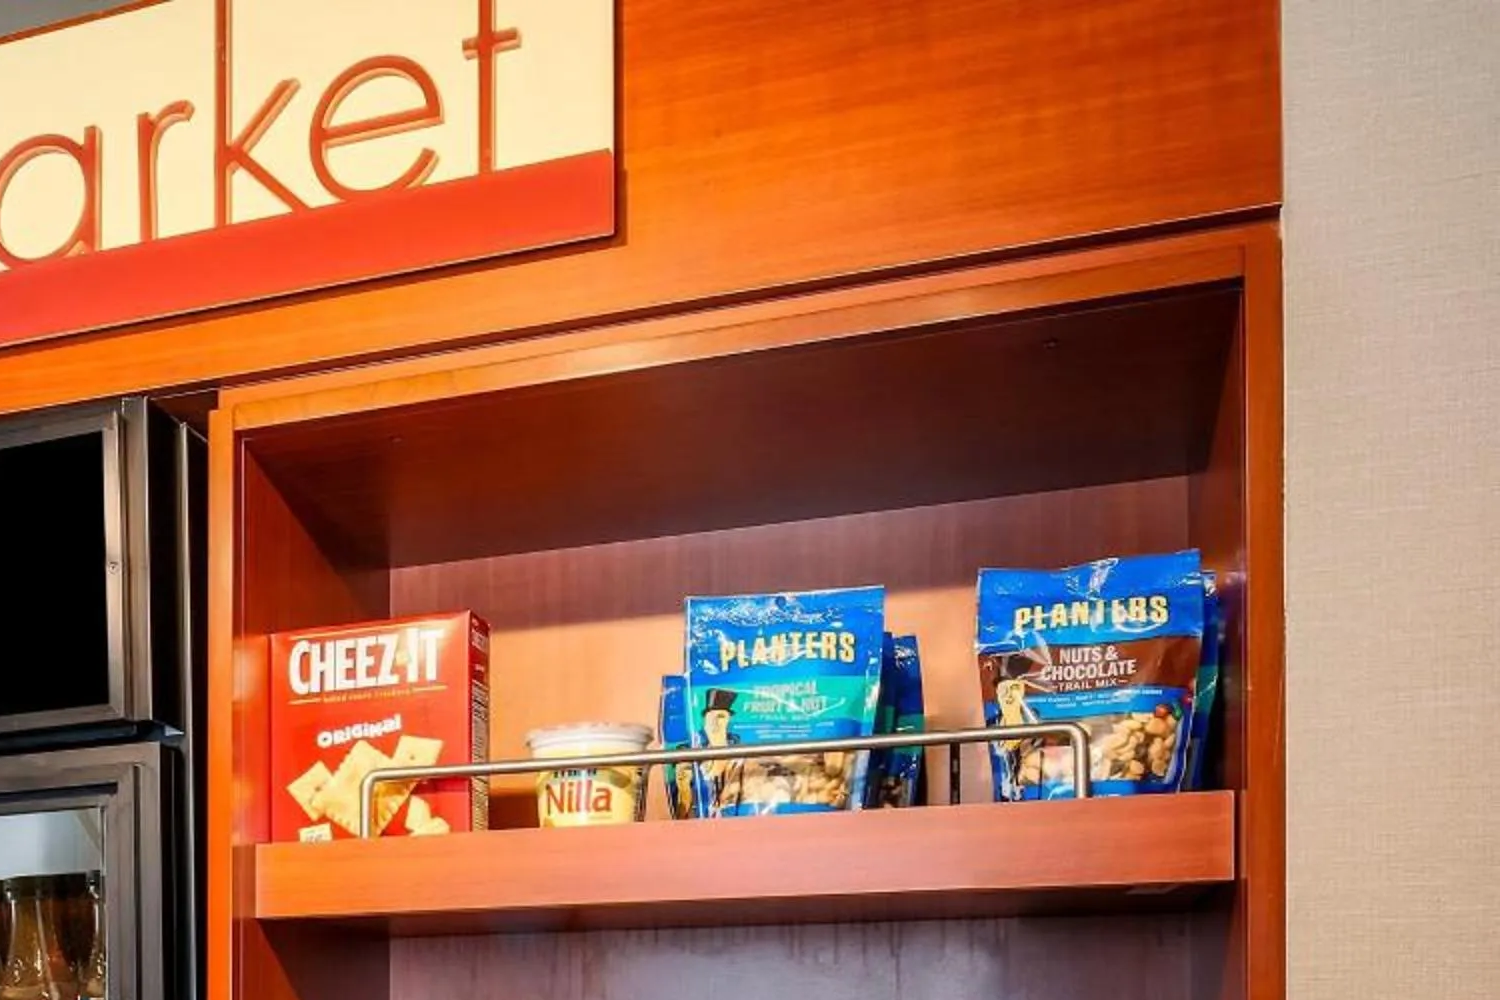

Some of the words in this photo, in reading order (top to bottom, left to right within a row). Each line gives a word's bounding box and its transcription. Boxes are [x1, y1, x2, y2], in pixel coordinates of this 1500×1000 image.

[720, 632, 856, 673] PLANTERS
[1059, 646, 1102, 665] NUTS
[1104, 645, 1120, 661] &
[1040, 658, 1138, 682] CHOCOLATE
[1057, 682, 1093, 693] TRAIL
[1095, 679, 1118, 690] MIX
[545, 779, 613, 816] Nilla
